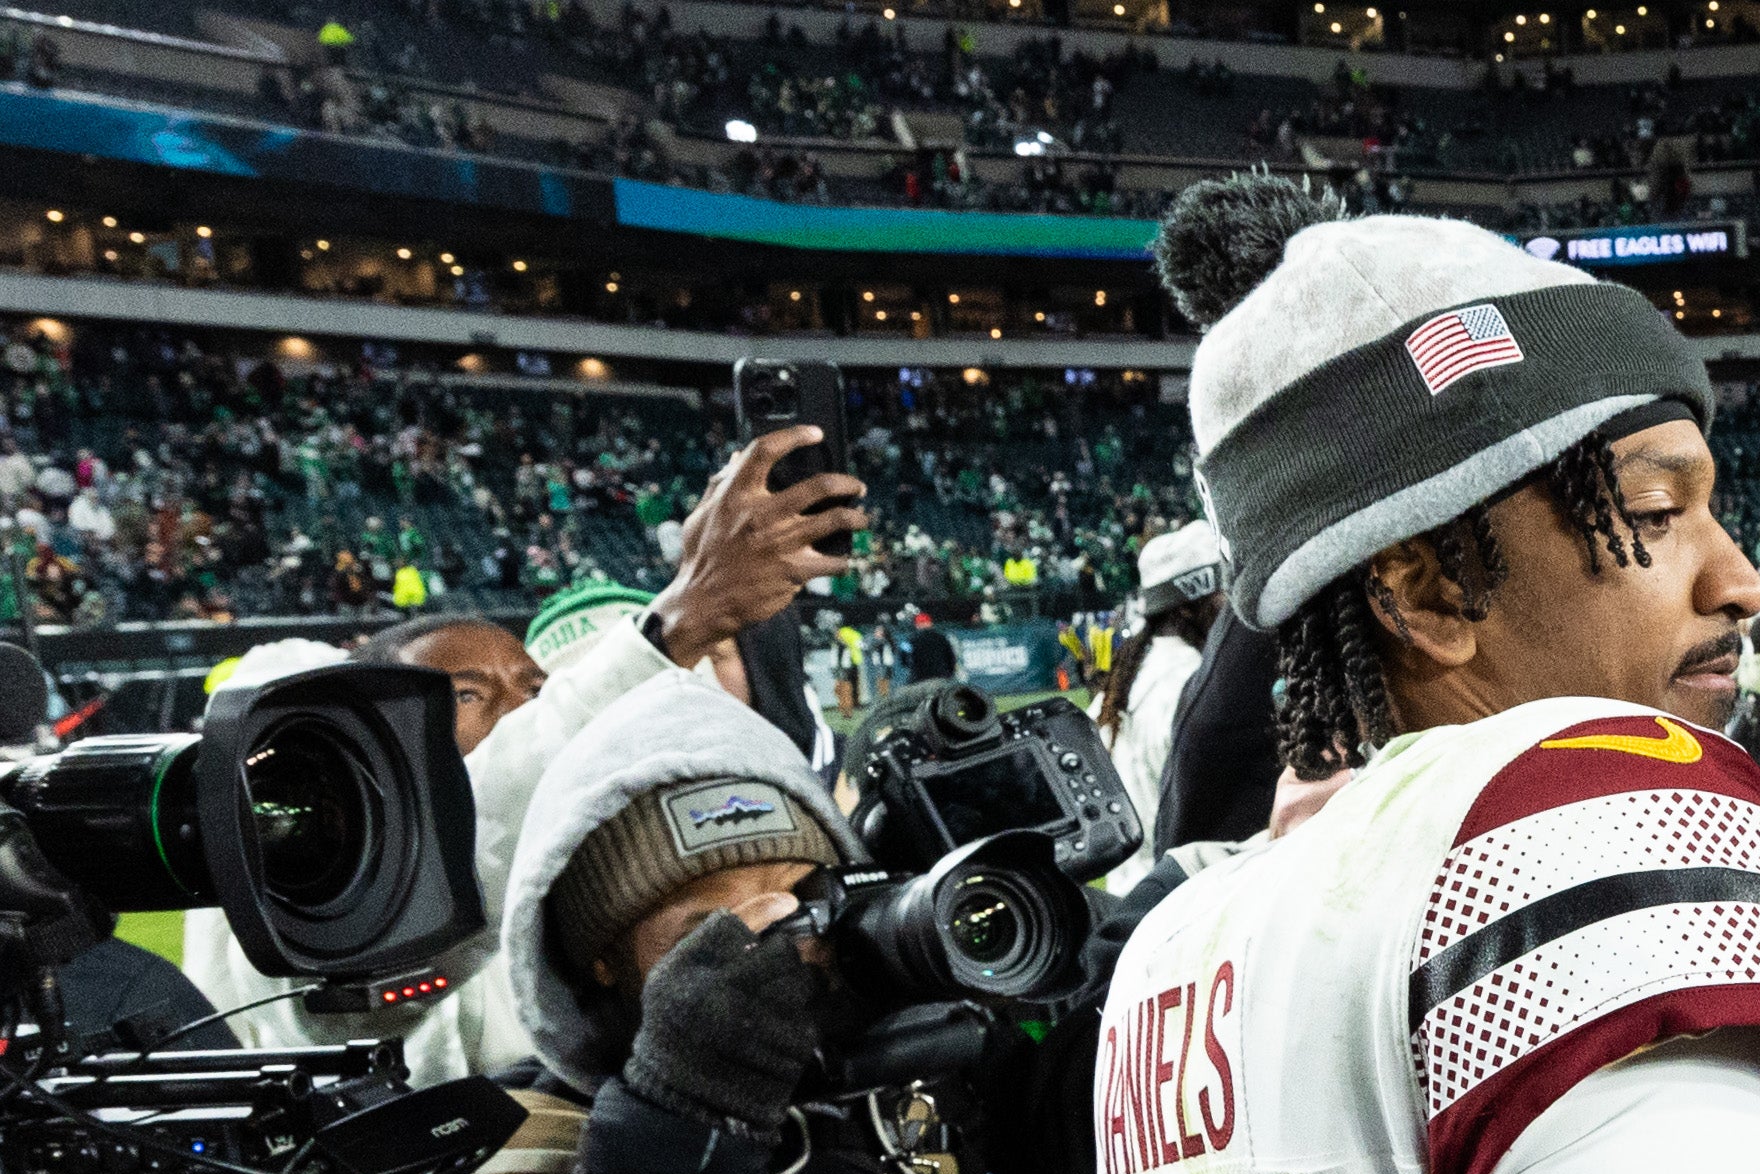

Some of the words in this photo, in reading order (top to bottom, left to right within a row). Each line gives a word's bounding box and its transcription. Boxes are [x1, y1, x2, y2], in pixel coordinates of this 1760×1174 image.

[1567, 238, 1612, 260] FREE
[1615, 234, 1685, 259] EAGLES
[843, 871, 889, 885] Nikon
